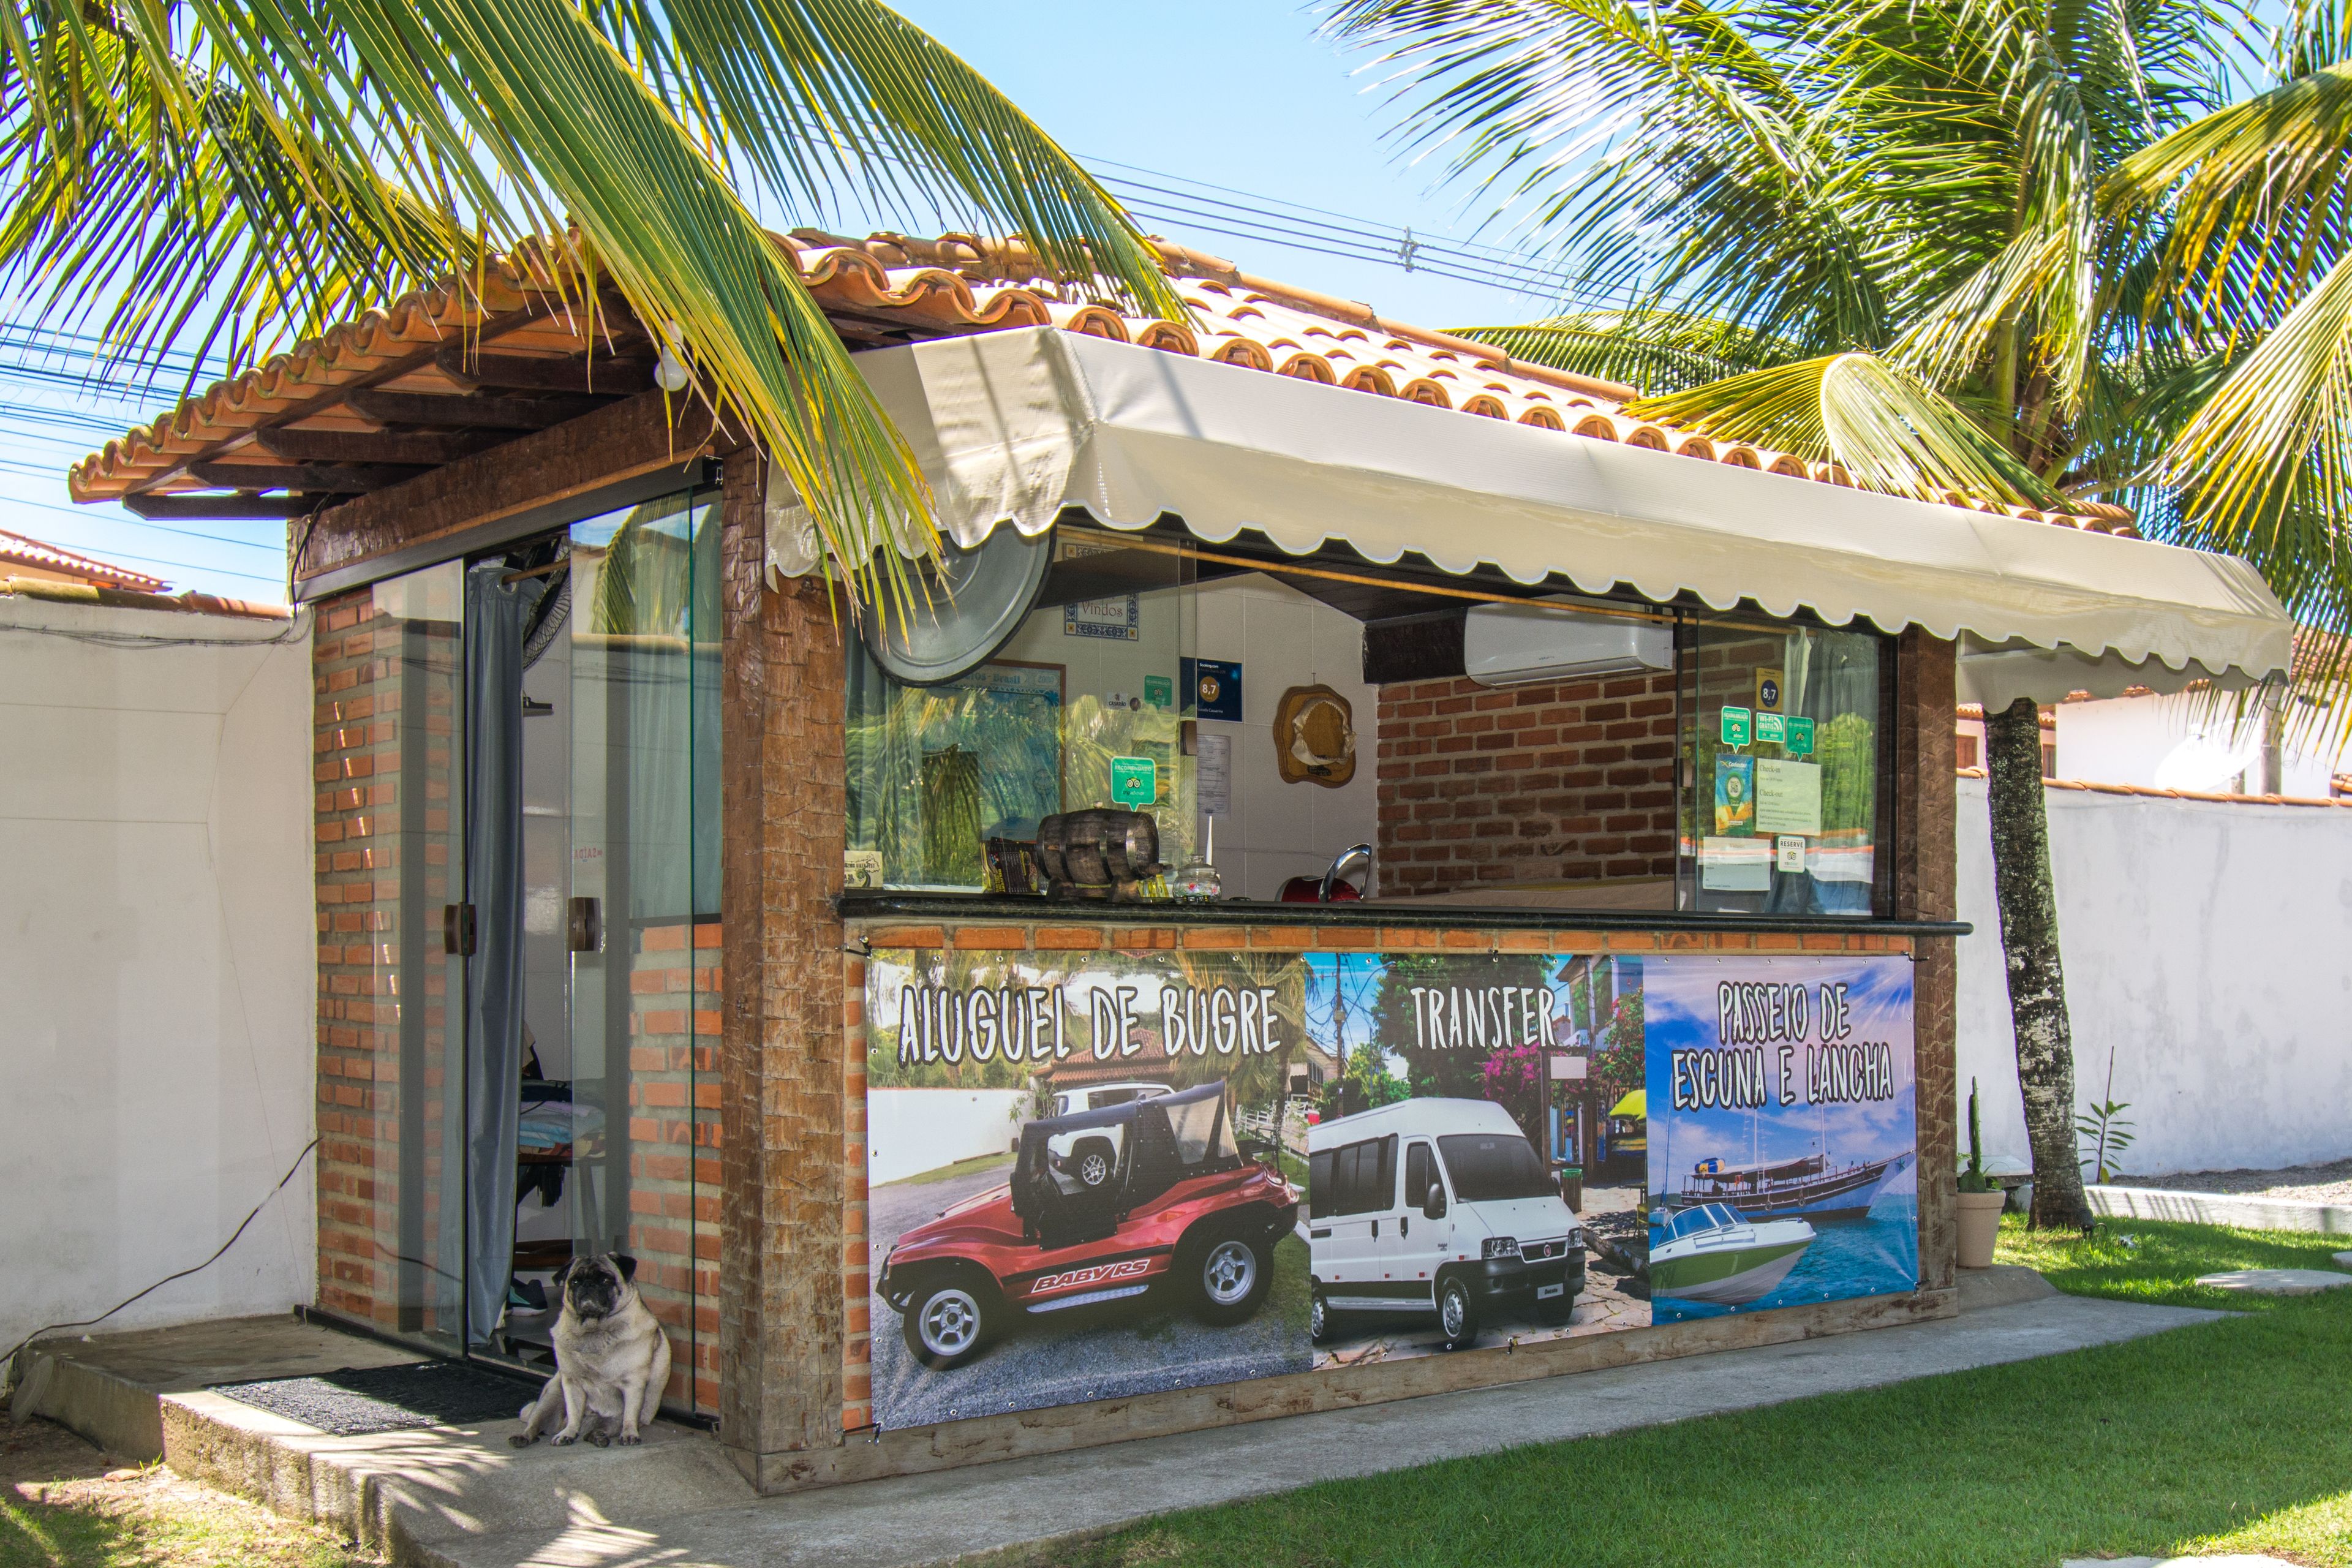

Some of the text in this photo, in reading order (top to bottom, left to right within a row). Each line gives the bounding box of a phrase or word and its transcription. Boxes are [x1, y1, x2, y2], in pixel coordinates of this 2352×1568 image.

[1082, 601, 1123, 617] Vindos
[993, 673, 1020, 684] Brasil
[1202, 684, 1216, 695] 8,7
[1763, 688, 1776, 701] 8,7
[1759, 764, 1781, 774] Check-in
[1759, 789, 1783, 798] Check-out
[1411, 986, 1556, 1050] TRANSFER
[1718, 982, 1850, 1044] PASSEIO DE
[899, 984, 1283, 1067] ALUGUEL DE BUGRE
[1672, 1042, 1893, 1110] ESCUNA E LANCHA
[1031, 1259, 1151, 1294] BABY RS
